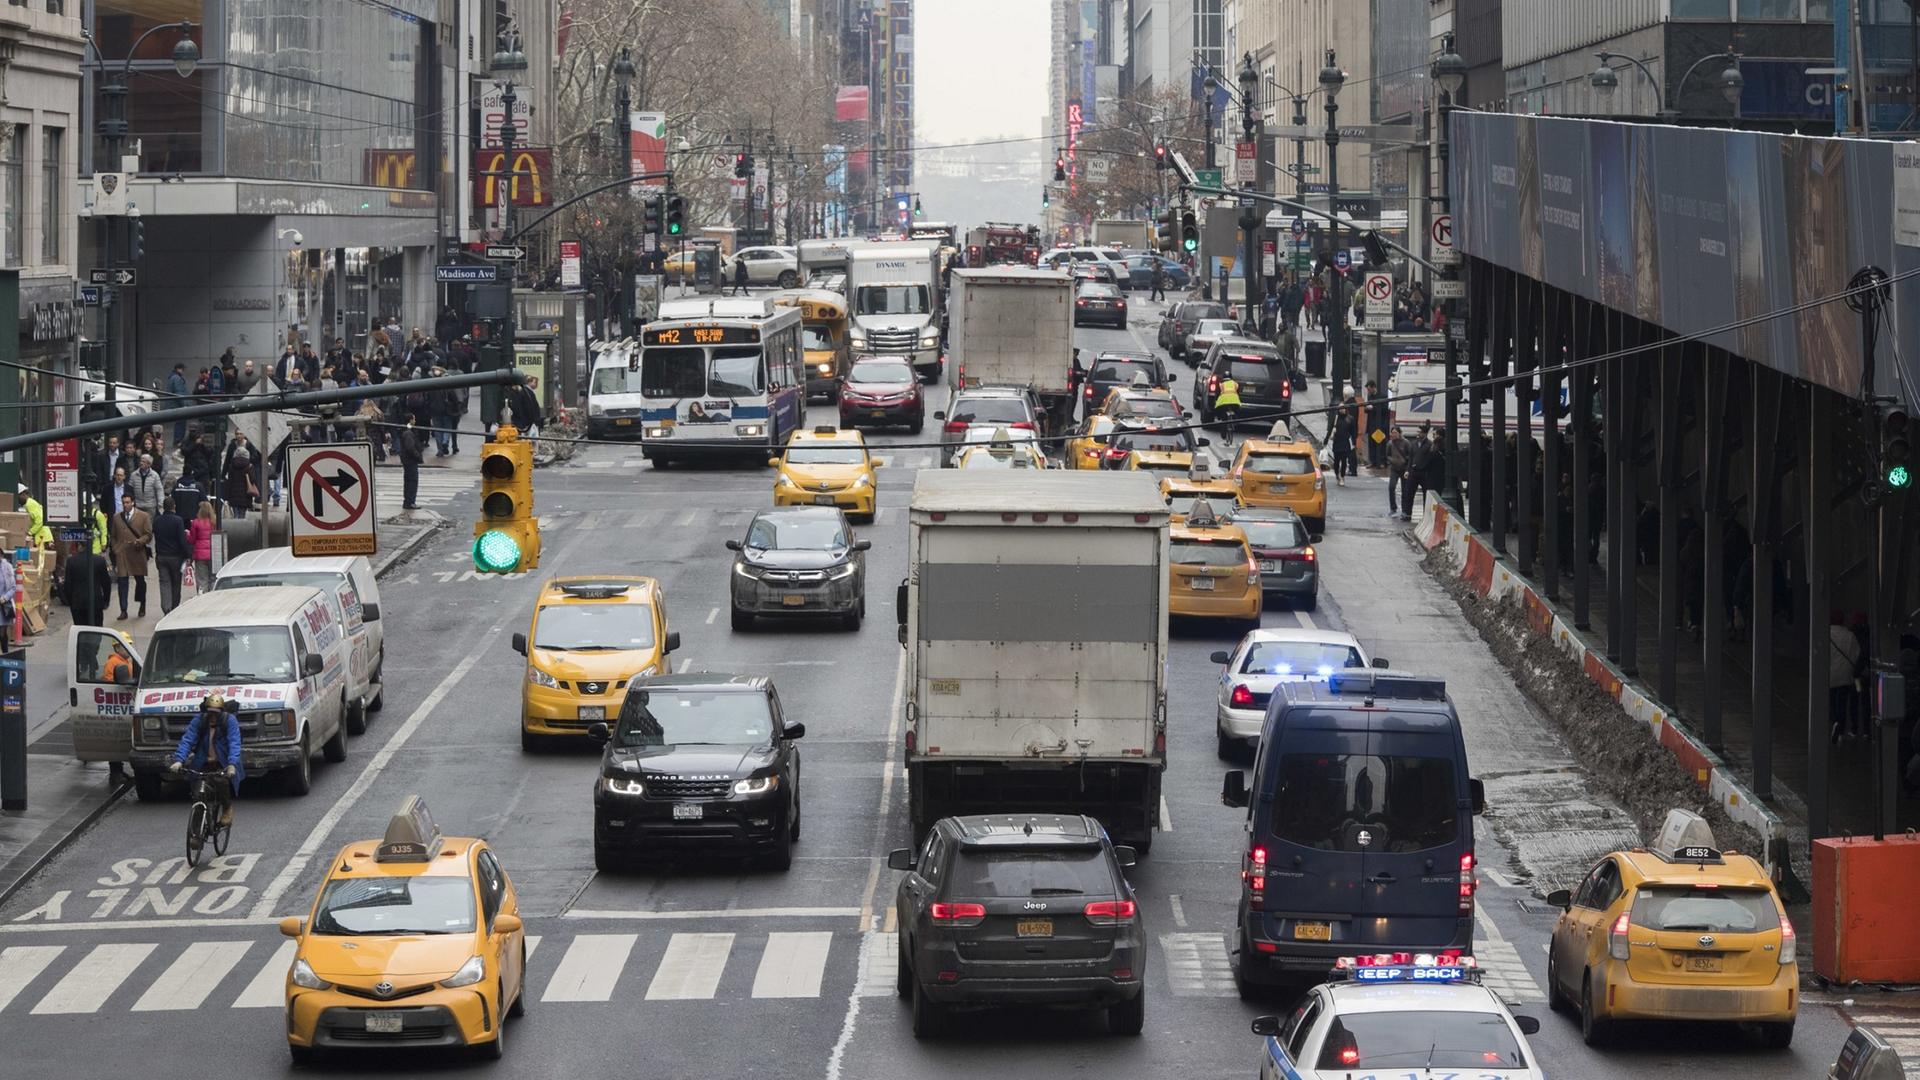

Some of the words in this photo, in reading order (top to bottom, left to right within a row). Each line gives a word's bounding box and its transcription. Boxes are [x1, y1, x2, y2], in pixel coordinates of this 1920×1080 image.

[1092, 161, 1104, 169] NO
[438, 267, 476, 279] Madison
[478, 268, 494, 279] Ave
[659, 329, 680, 343] M42
[48, 471, 55, 482] 3
[9, 670, 18, 685] P
[144, 690, 209, 705] CHIEF
[227, 686, 281, 700] FIRE
[97, 704, 135, 715] PREVE
[391, 845, 412, 854] 9J35
[1686, 848, 1709, 857] 8E52
[96, 853, 263, 886] BUS
[12, 885, 250, 922] ONLY
[1023, 901, 1047, 910] Jeep
[1413, 968, 1460, 979] BACK
